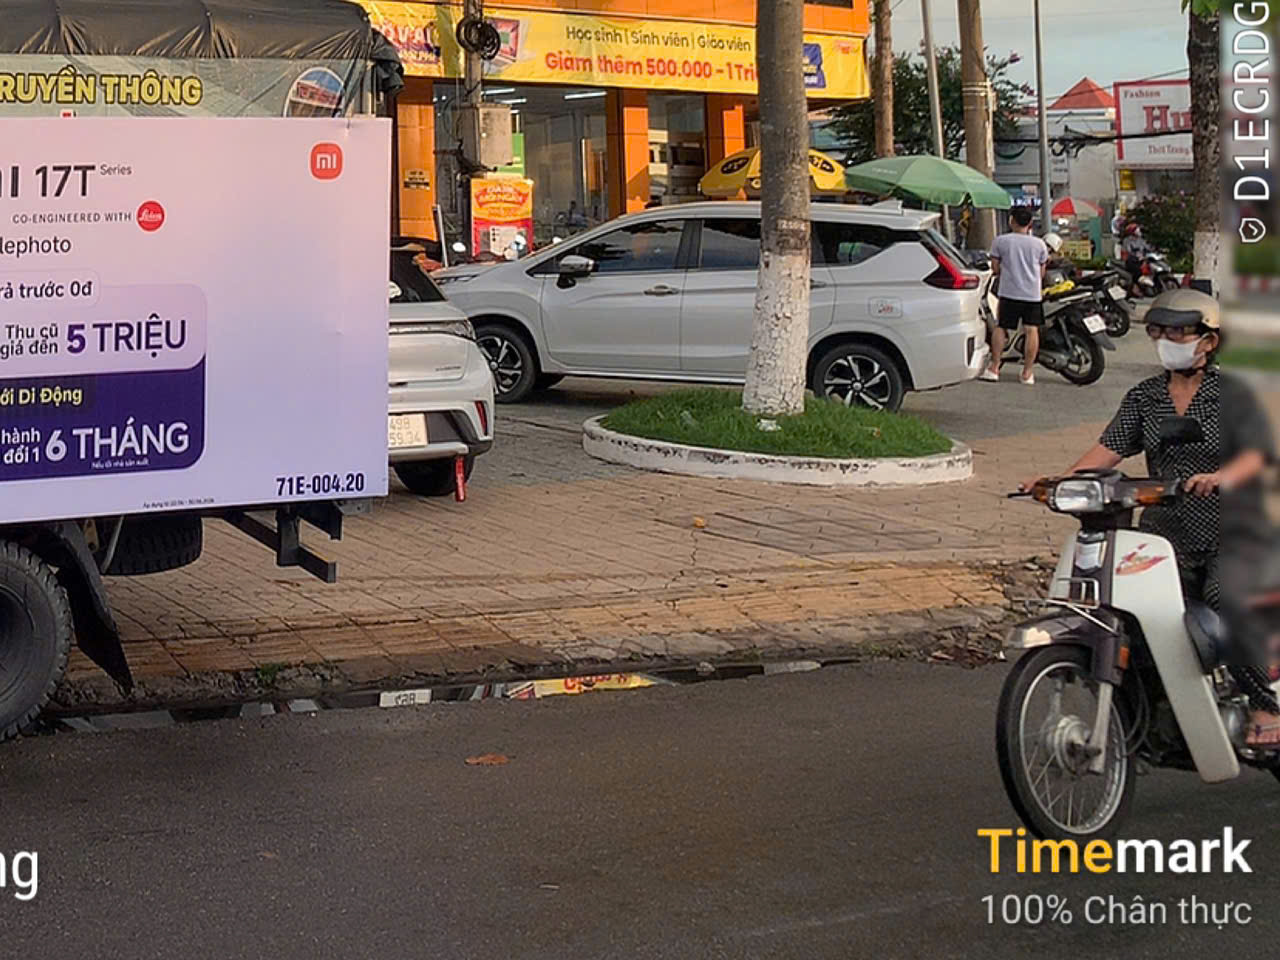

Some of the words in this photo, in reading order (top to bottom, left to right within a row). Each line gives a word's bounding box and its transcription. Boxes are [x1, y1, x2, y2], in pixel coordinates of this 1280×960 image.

[566, 26, 591, 44] Học
[594, 27, 621, 42] sinh
[631, 30, 659, 45] Sinh
[662, 32, 688, 47] viên
[697, 33, 725, 50] Giáo
[726, 36, 751, 51] viên
[545, 49, 593, 73] Giảm
[597, 55, 643, 75] thêm
[646, 58, 712, 79] 500.000
[734, 64, 758, 81] Tri
[99, 68, 203, 106] THÔNG
[1143, 105, 1192, 132] Hu
[35, 165, 96, 197] 17T
[100, 163, 132, 176] Series
[12, 212, 100, 224] CO-ENGINEERED
[104, 211, 132, 222] WITH
[19, 280, 64, 298] trước
[70, 281, 93, 297] 0đ
[5, 323, 35, 340] Thu
[39, 323, 59, 342] cũ
[66, 323, 86, 354] 5
[92, 313, 186, 359] TRIỆU
[0, 341, 24, 360] giá
[18, 387, 36, 405] Di
[40, 386, 83, 407] Động
[1, 426, 41, 445] hành
[45, 429, 67, 462] 6
[72, 416, 189, 460] THÁNG
[276, 472, 365, 497] 71E-004.20
